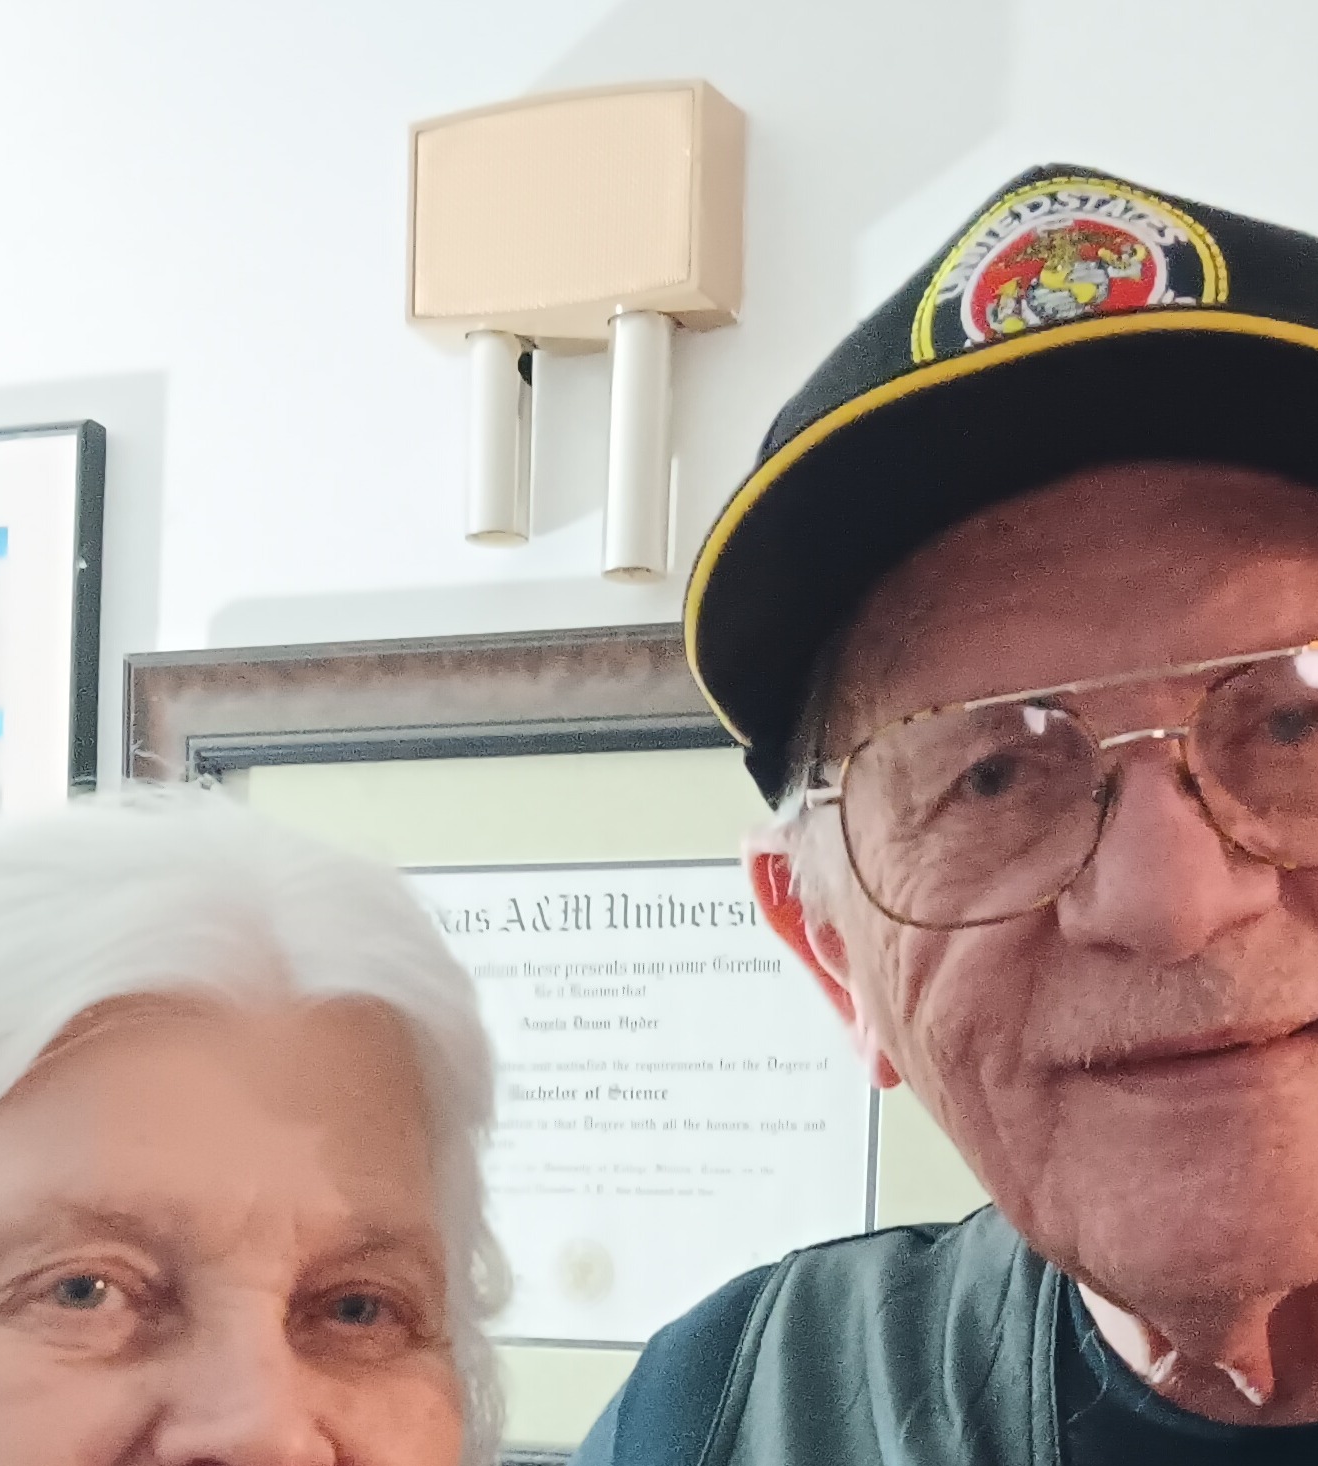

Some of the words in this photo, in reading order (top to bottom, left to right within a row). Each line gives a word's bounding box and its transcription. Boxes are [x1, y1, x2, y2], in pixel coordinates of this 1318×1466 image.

[498, 894, 591, 933] A&M
[604, 893, 756, 929] Universi
[565, 959, 627, 980] presents
[612, 1059, 629, 1073] the
[635, 1059, 714, 1075] requirements
[742, 1057, 761, 1073] the
[585, 1084, 602, 1101] of
[607, 1082, 670, 1101] Science
[682, 1118, 701, 1131] the
